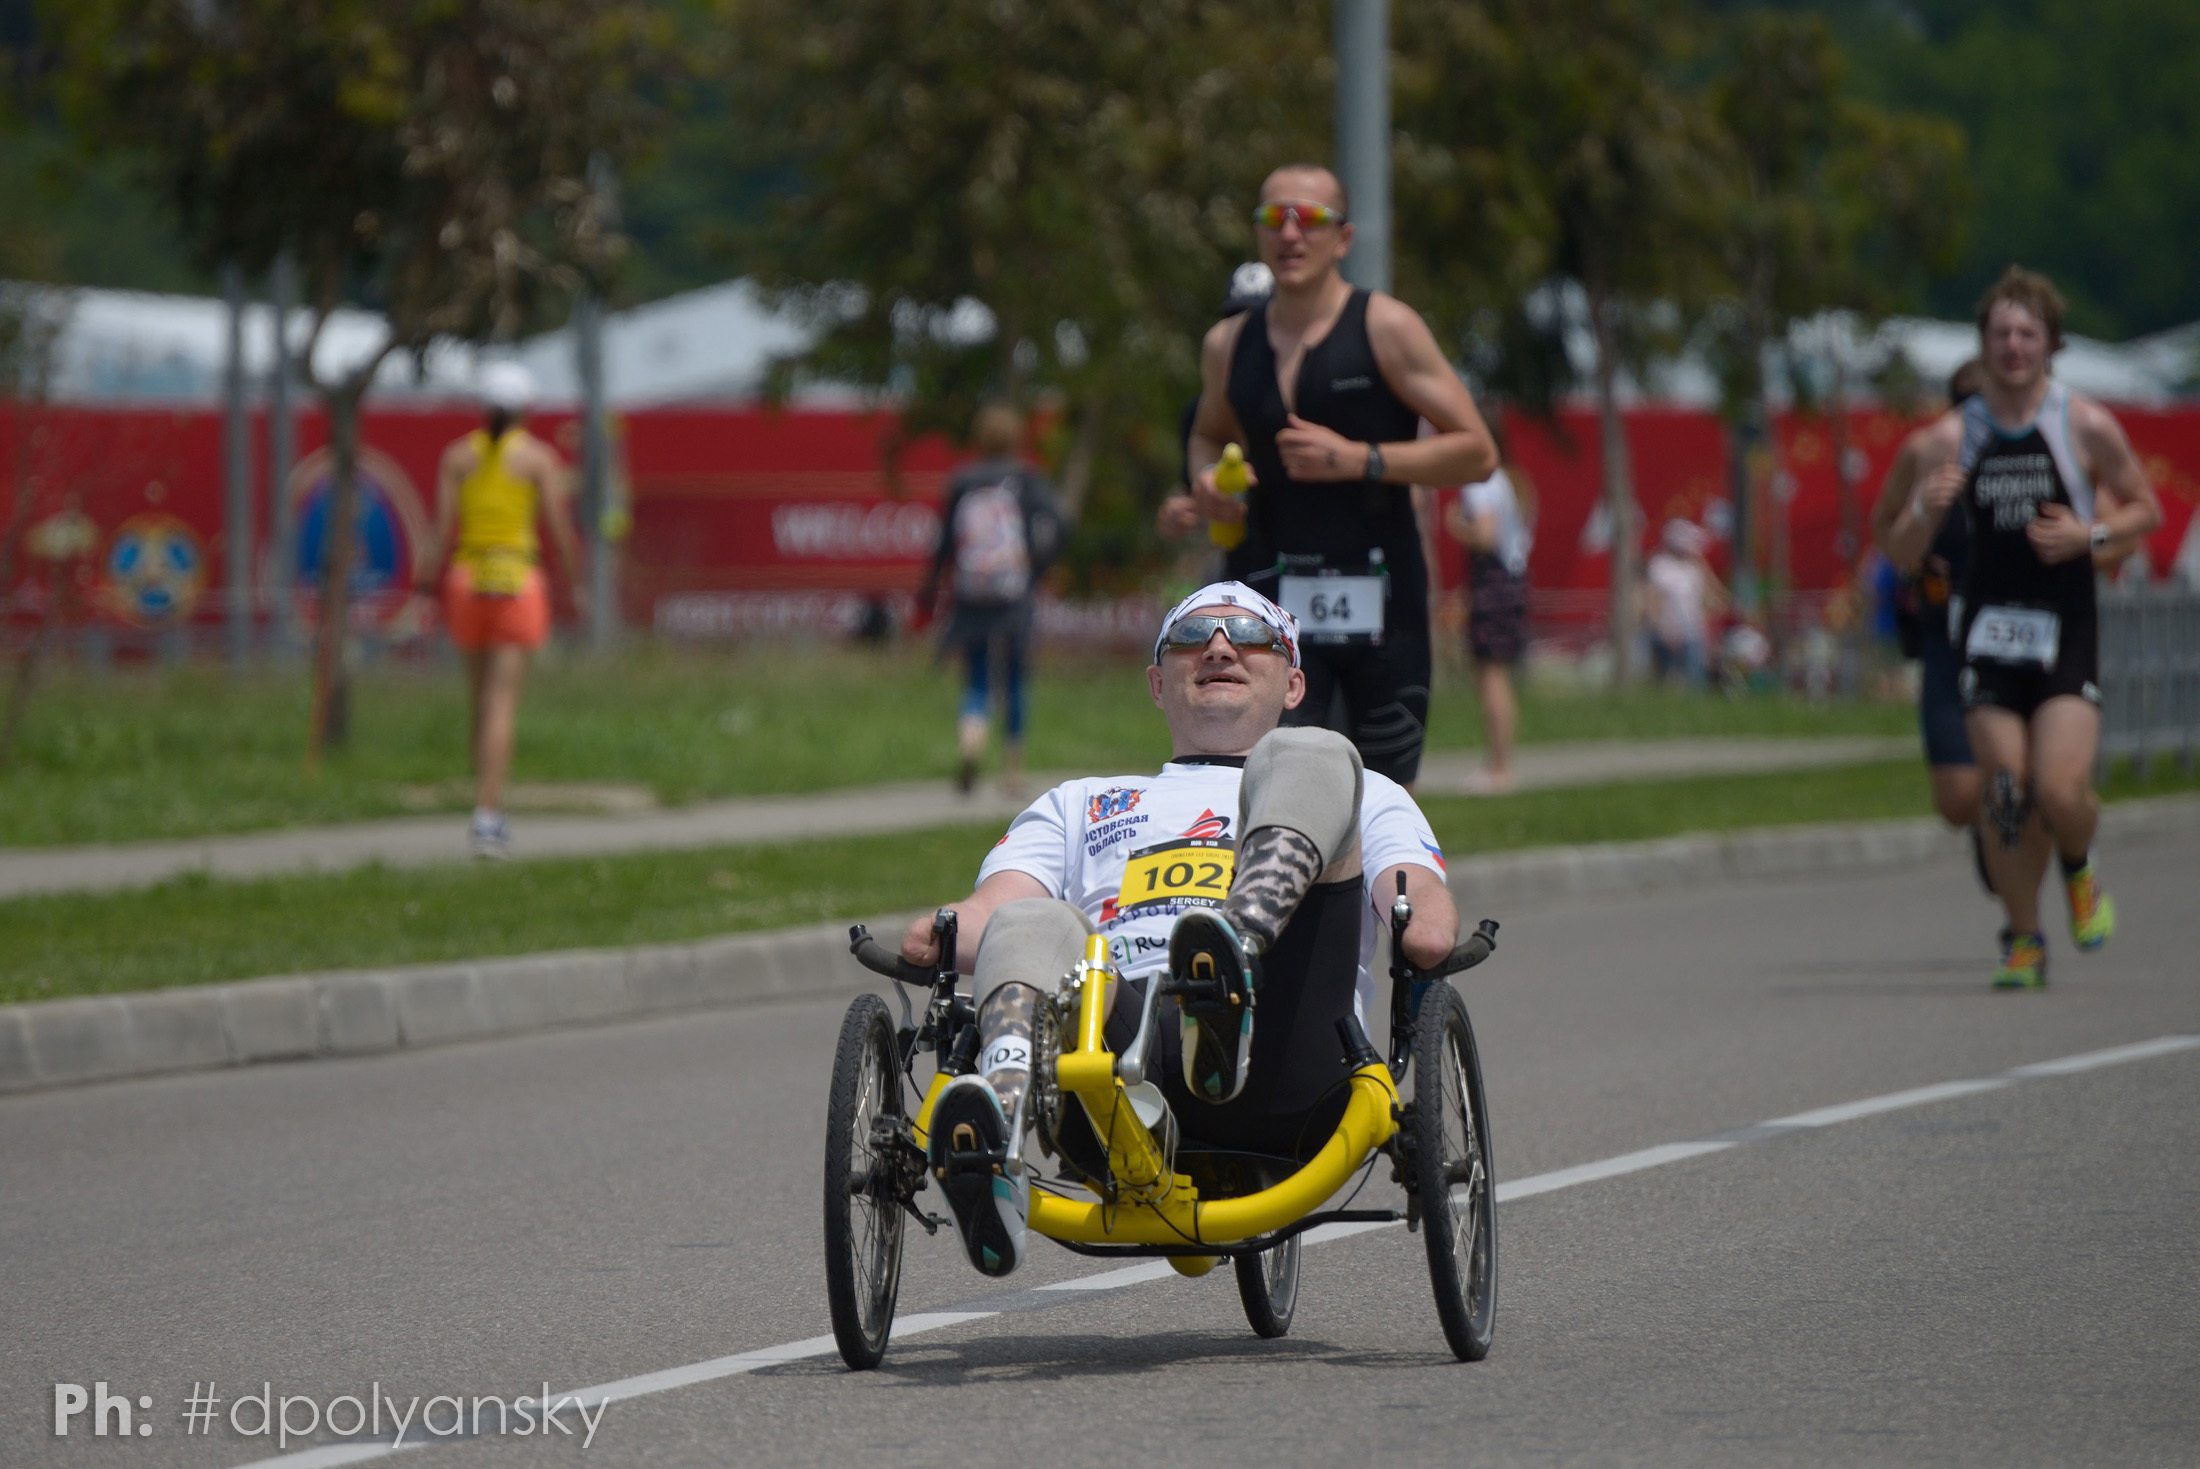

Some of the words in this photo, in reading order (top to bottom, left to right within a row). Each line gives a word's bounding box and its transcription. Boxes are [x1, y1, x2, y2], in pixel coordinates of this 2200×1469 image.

[1310, 592, 1352, 623] 64
[1088, 828, 1137, 857] ОБЛАСТЬ
[1144, 862, 1234, 891] 102
[1169, 897, 1216, 907] SERGEY
[1135, 936, 1166, 954] RU
[988, 1047, 1031, 1070] 102
